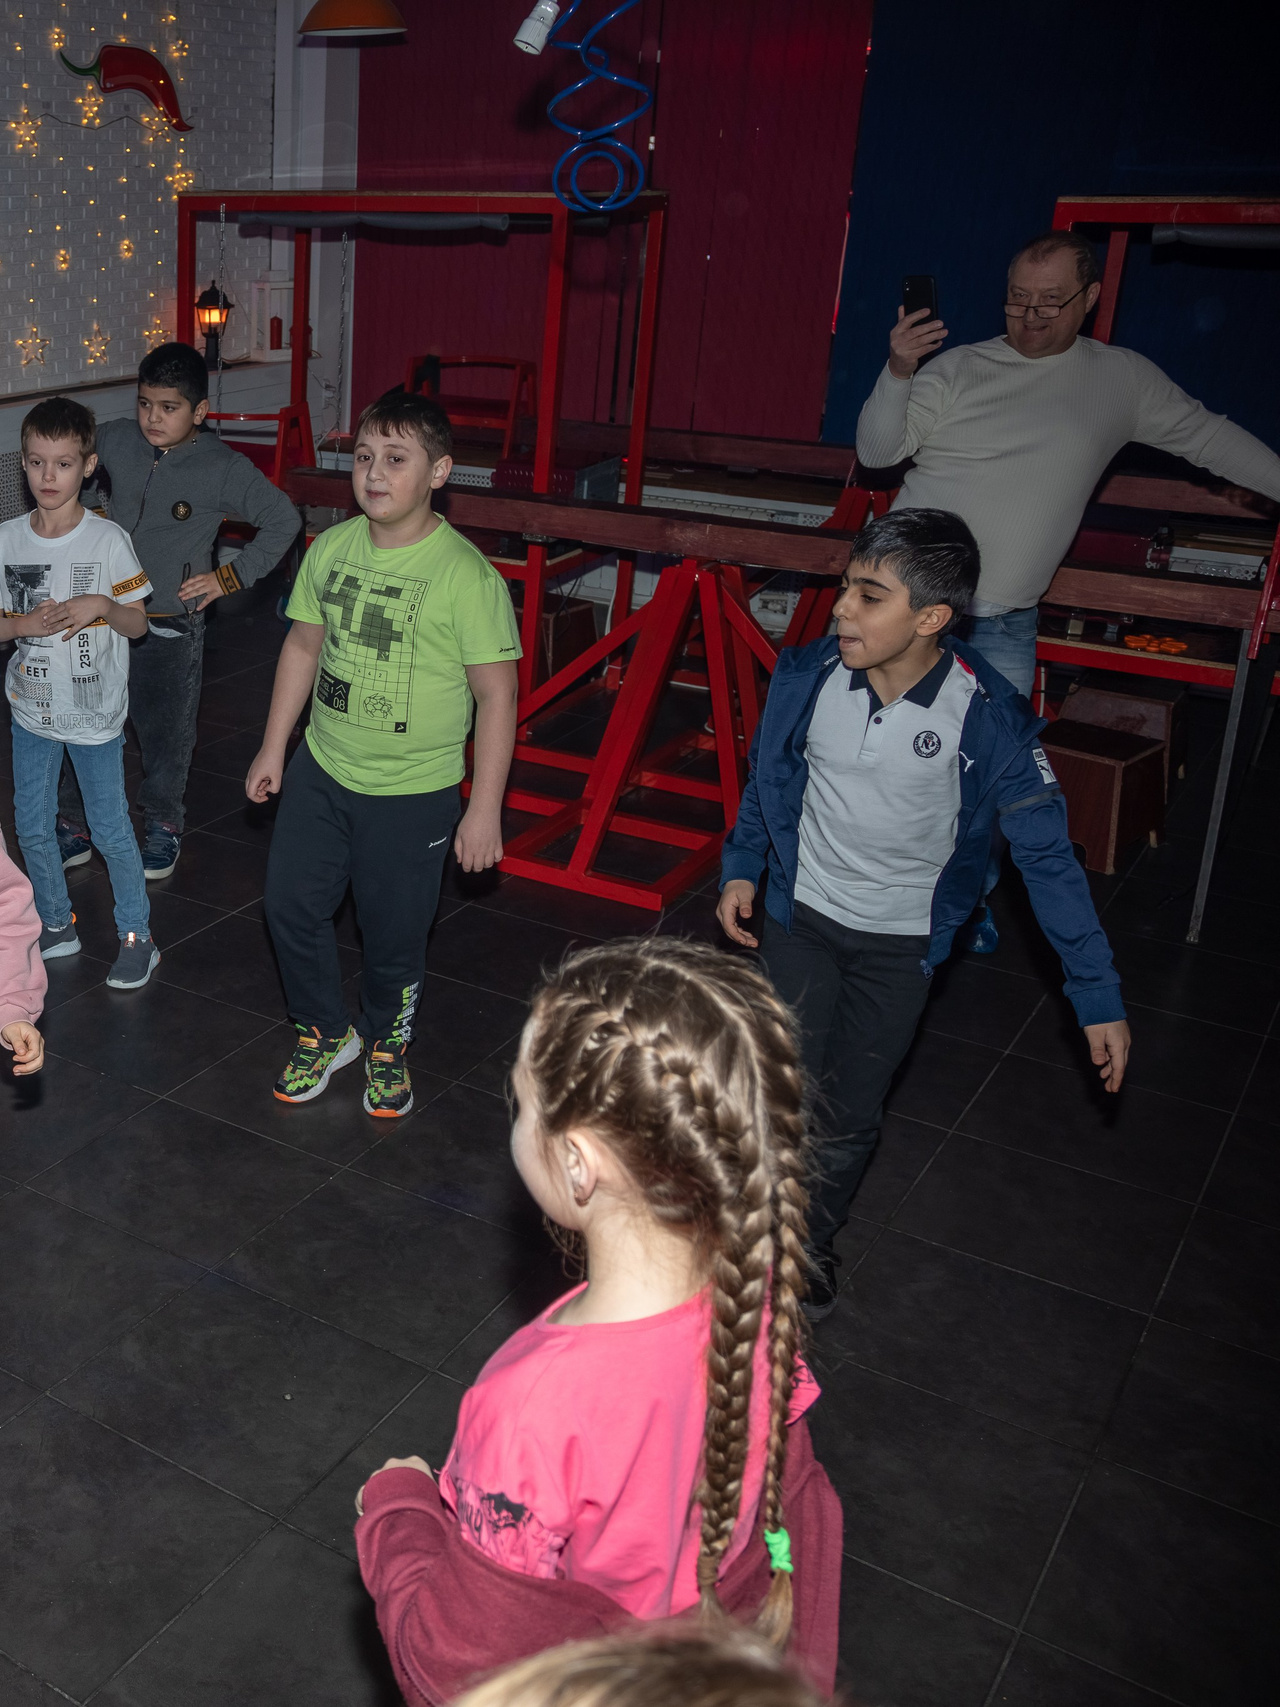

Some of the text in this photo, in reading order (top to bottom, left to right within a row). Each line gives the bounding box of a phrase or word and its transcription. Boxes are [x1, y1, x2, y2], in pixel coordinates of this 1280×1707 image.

[115, 582, 134, 593] STREET
[78, 633, 91, 668] 23:59
[72, 674, 100, 684] STREET
[333, 697, 346, 711] 08
[56, 711, 117, 729] URBAN
